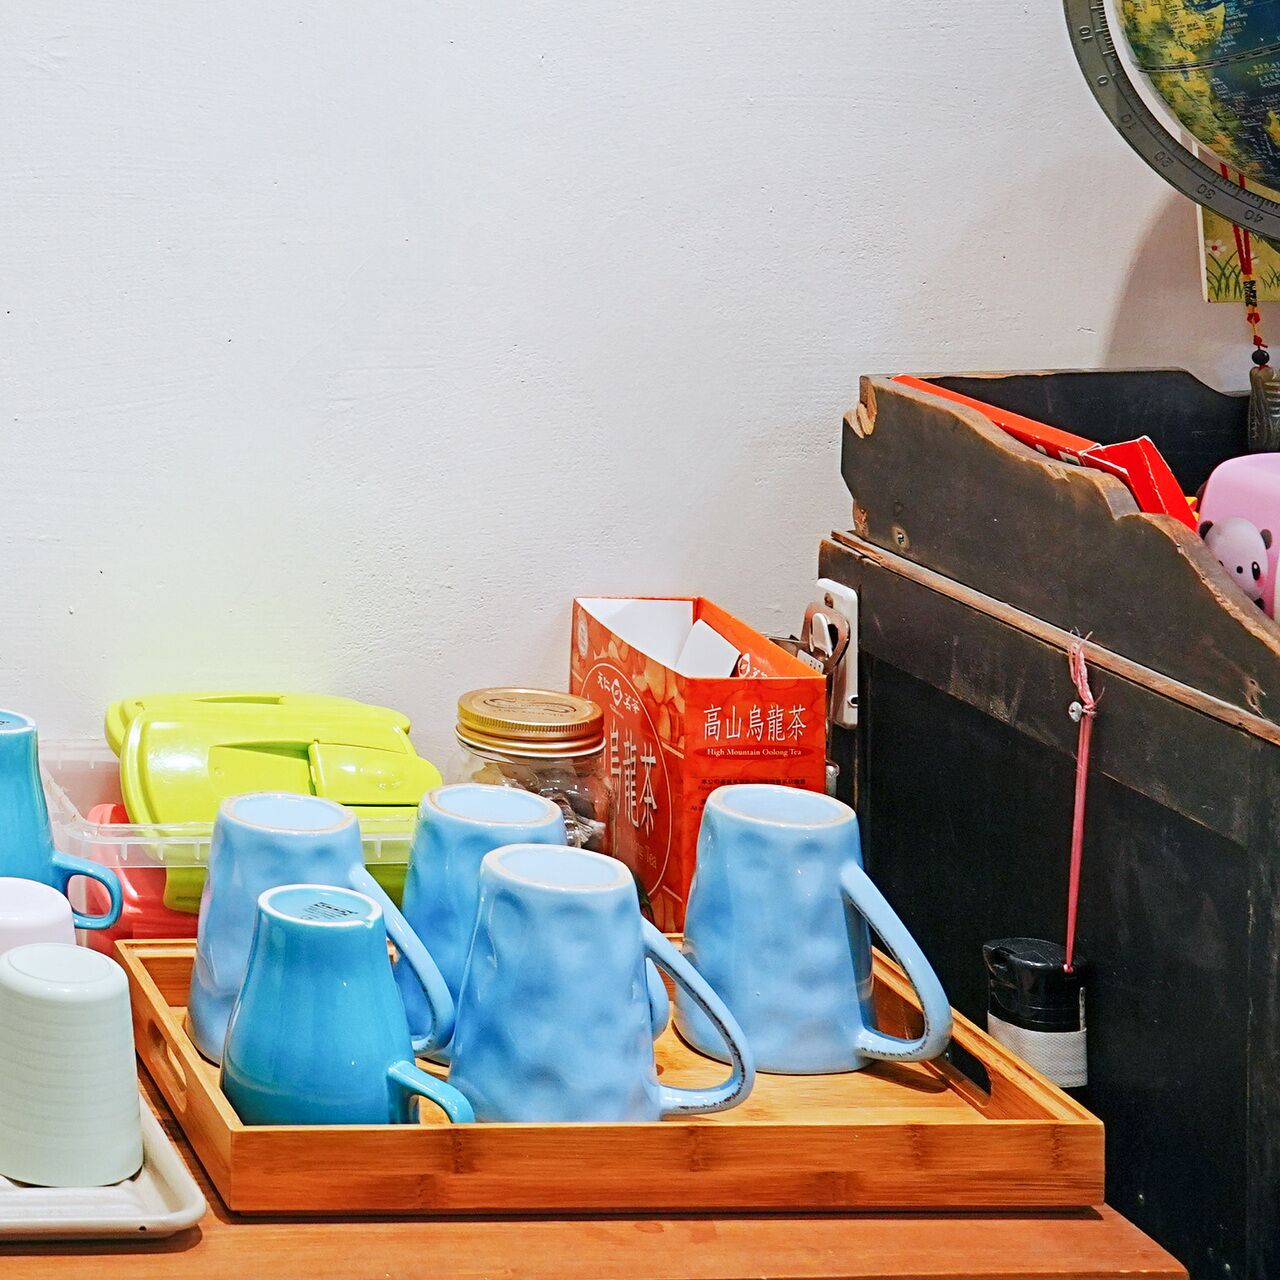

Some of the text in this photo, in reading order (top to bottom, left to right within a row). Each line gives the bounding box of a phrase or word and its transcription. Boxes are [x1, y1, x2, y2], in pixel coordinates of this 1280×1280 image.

[1079, 25, 1093, 41] 10
[1097, 75, 1108, 86] 0
[704, 704, 807, 741] 高山烏龍茶
[707, 749, 724, 757] High
